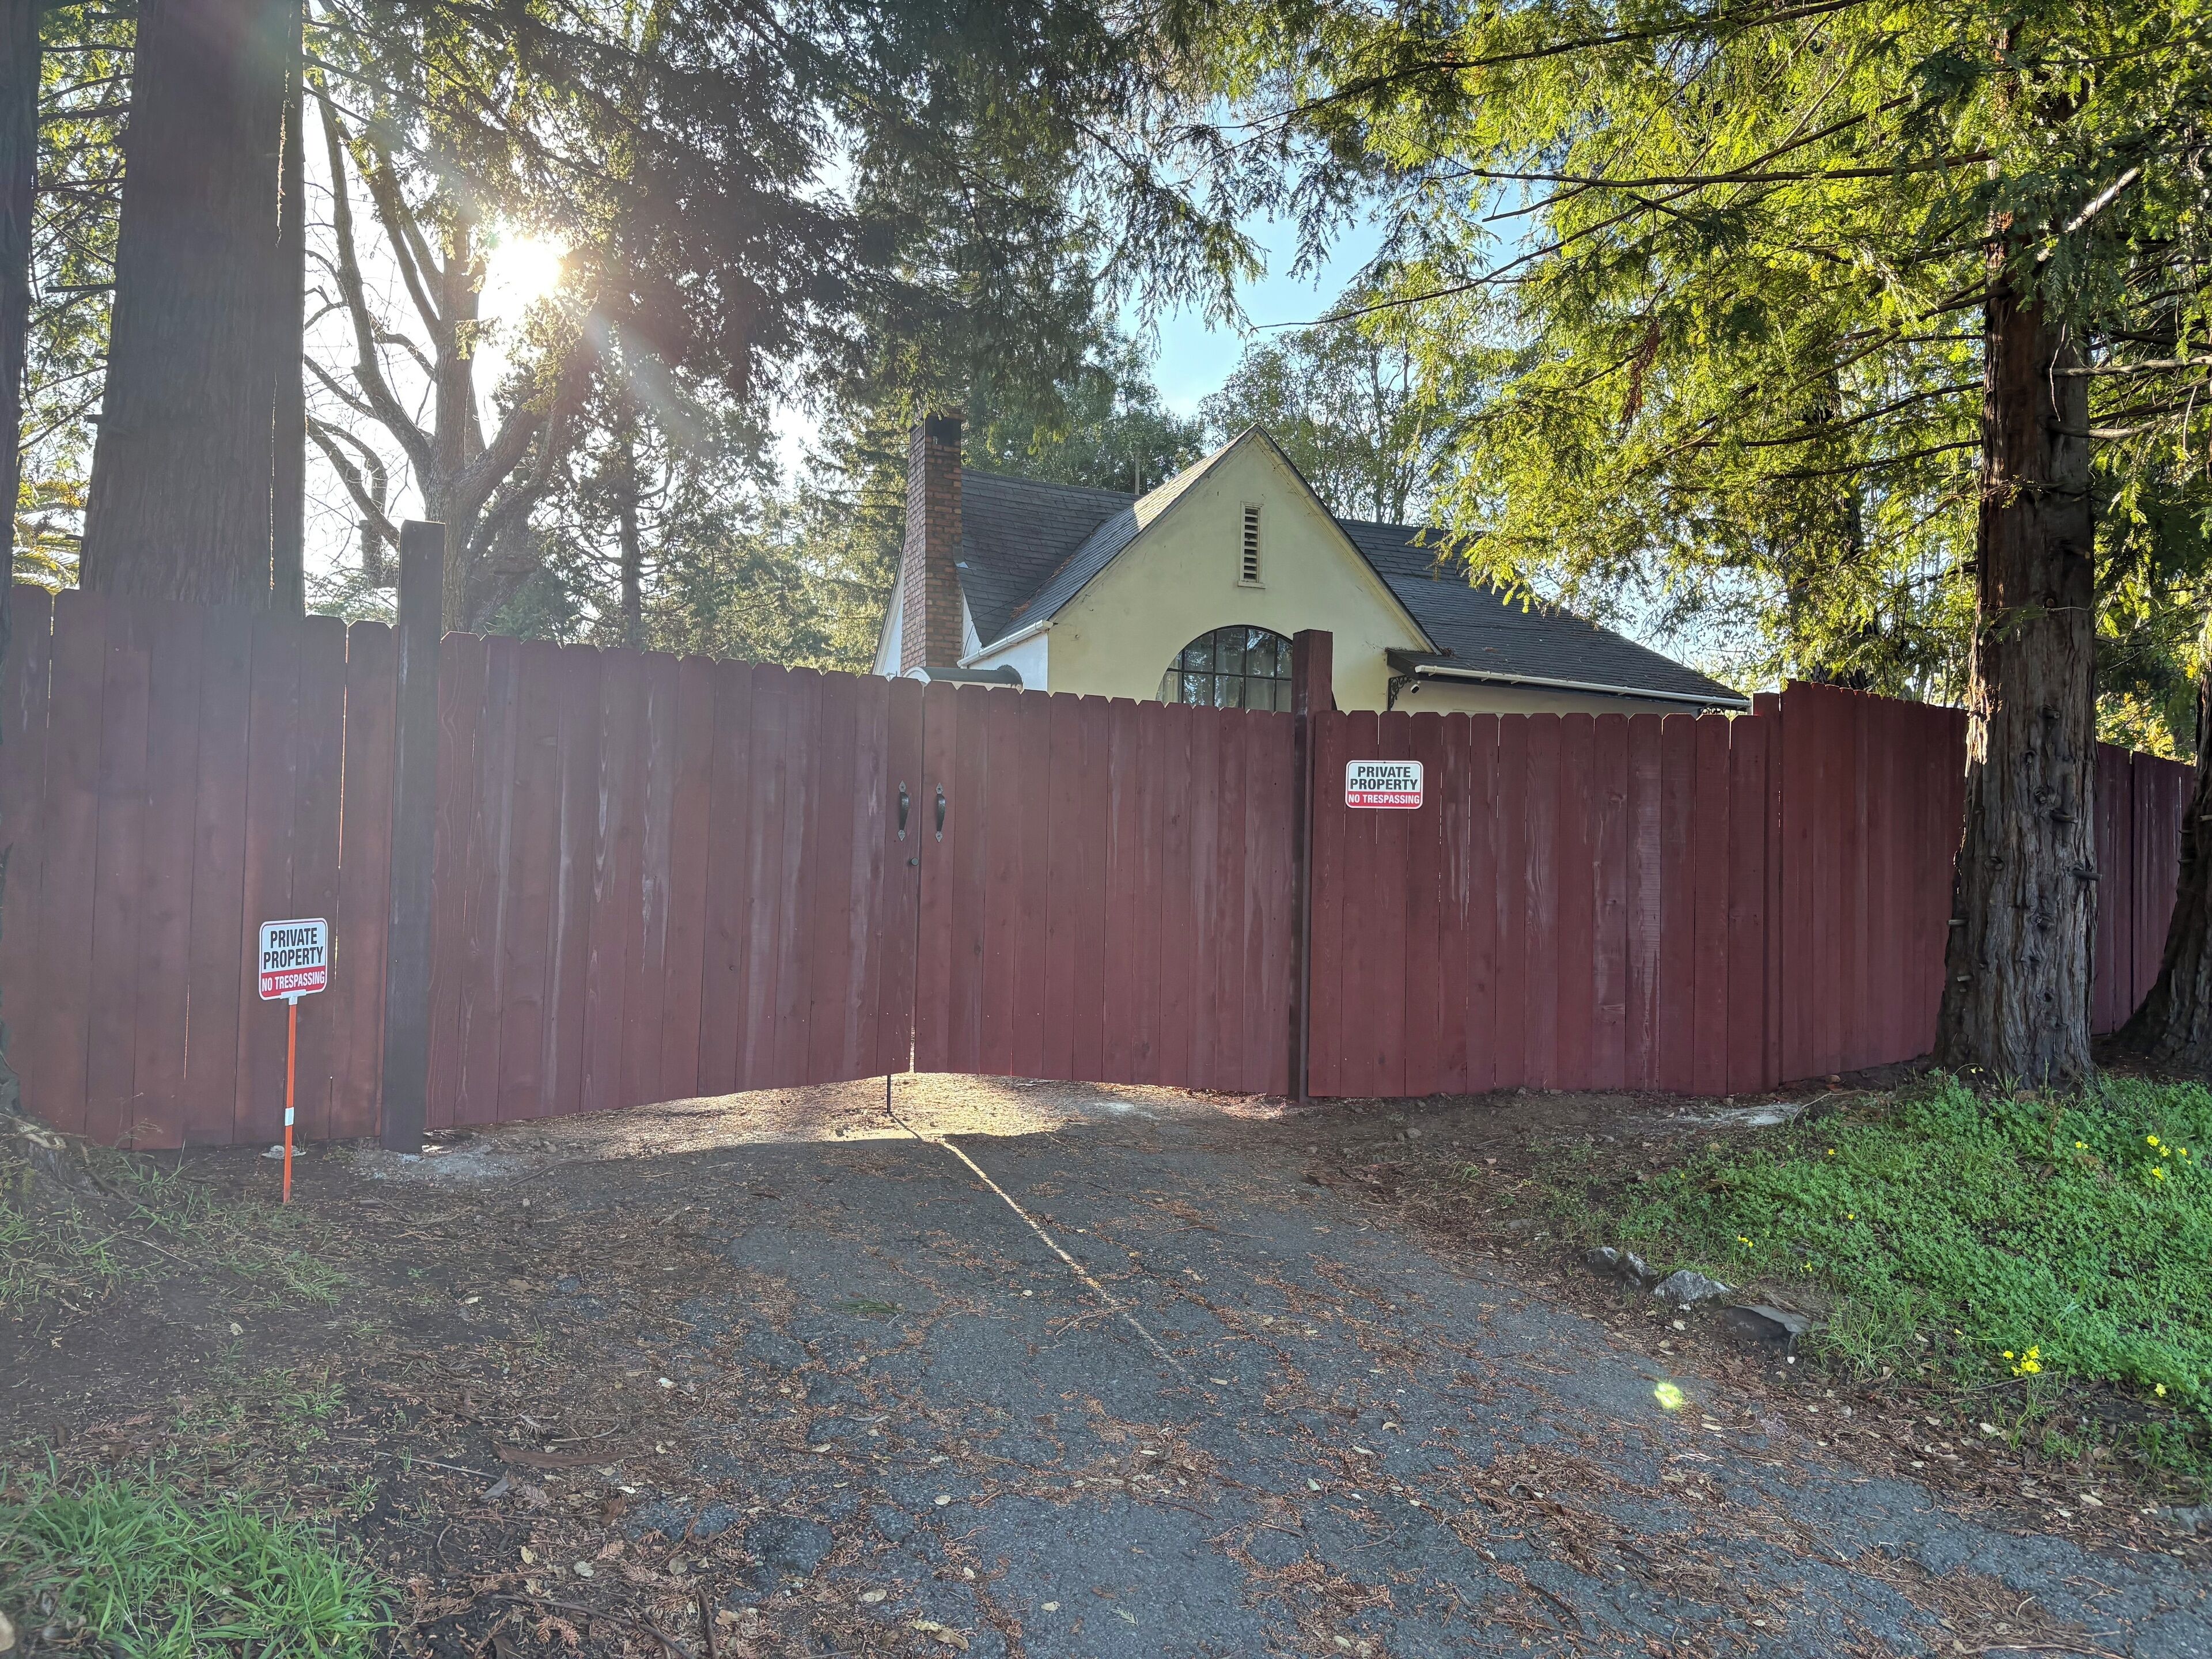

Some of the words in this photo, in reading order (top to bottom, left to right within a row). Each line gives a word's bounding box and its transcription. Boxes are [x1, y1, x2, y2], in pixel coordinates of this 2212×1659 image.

[1358, 766, 1411, 778] PRIVATE
[1350, 779, 1418, 790] PROPERTY
[1349, 794, 1359, 803] NO
[1362, 794, 1419, 804] TRESPASSING
[270, 927, 317, 948] PRIVATE
[263, 946, 324, 969] PROPERTY
[262, 978, 272, 992] NO
[275, 971, 325, 990] TRESPASSING
